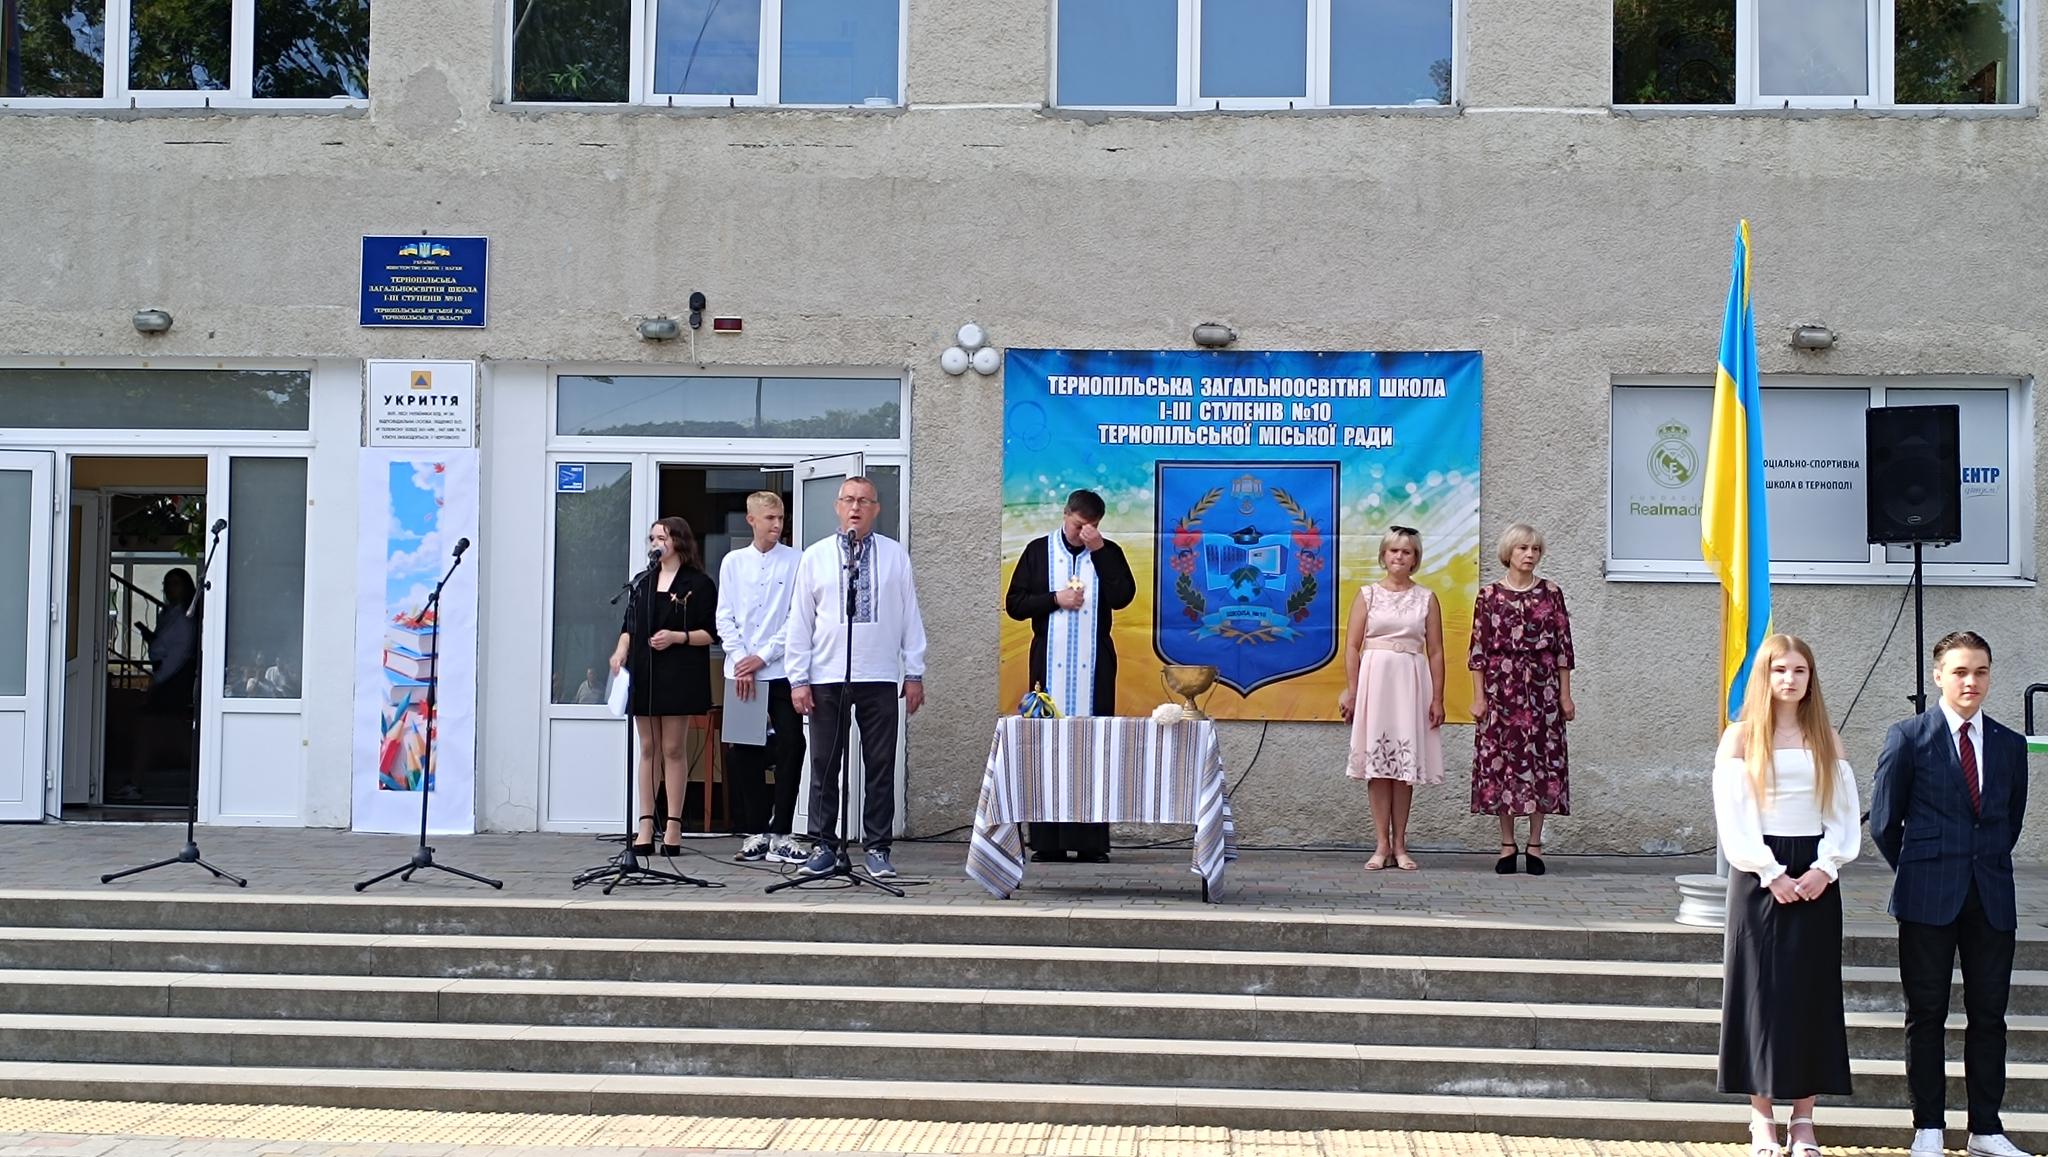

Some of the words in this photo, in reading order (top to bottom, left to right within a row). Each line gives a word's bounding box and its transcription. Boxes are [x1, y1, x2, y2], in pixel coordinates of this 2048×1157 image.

[390, 276, 456, 284] ТЕРНОПІЛЬСЬКА
[1048, 376, 1193, 396] ТЕРНОПІЛЬСЬКА
[1200, 377, 1371, 397] ЗАГАЛЬНООСВІТНЯ
[1379, 378, 1446, 397] ШКОЛА
[384, 395, 459, 406] УКРИТТЯ
[1199, 402, 1284, 421] СТУПЕНІВ
[1292, 402, 1332, 421] №10
[1098, 424, 1251, 445] ТЕРНОПІЛЬСЬКОЇ
[1259, 424, 1337, 446] МІСЬКОЇ
[1344, 427, 1393, 449] РАДИ
[1763, 460, 1860, 469] ОЦІАЛЬНО-СПОРТИВНА
[1962, 468, 2000, 483] ЕНТР
[1765, 481, 1796, 489] ШКОЛА
[1798, 481, 1803, 489] В
[1806, 481, 1852, 489] ТЕРНОПОЛІ
[1630, 502, 1702, 516] Realmadr
